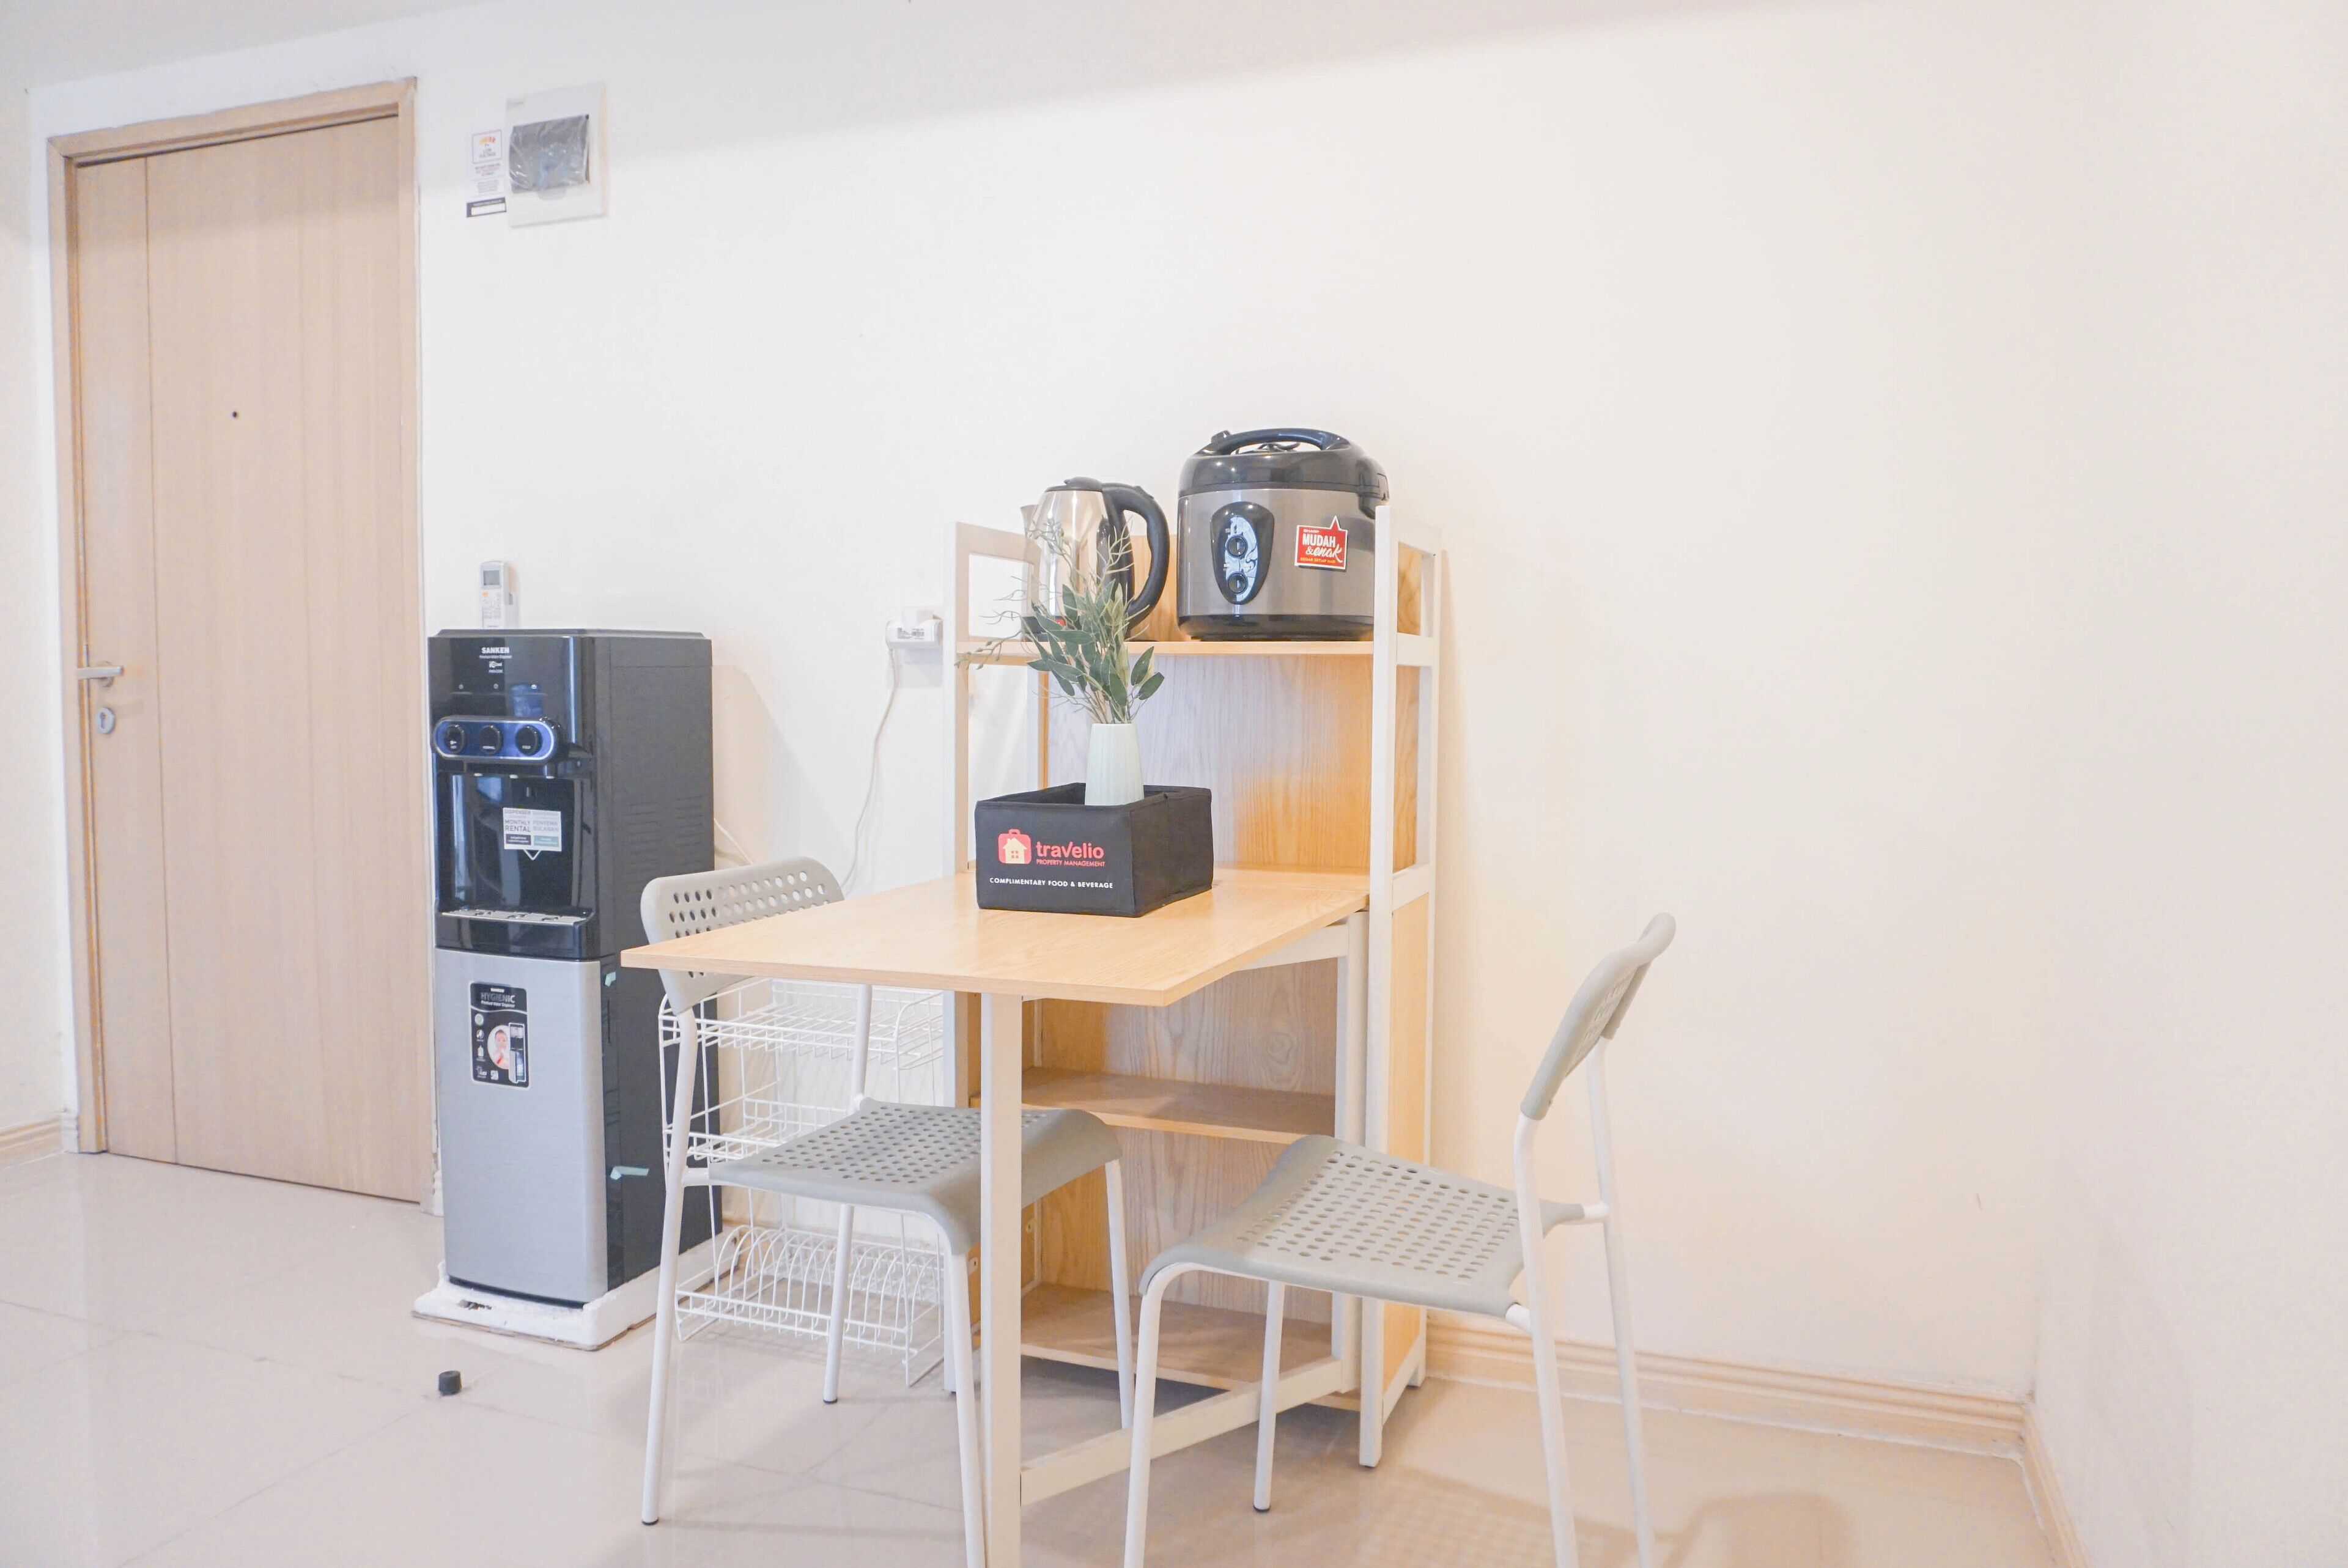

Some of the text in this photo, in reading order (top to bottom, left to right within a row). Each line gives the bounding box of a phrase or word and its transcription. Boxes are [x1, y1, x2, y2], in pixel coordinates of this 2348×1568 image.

[1302, 533, 1335, 548] MUDAH
[1036, 841, 1104, 859] travelio
[990, 877, 1046, 886] COMPLIMENTARY
[481, 992, 515, 1003] HYGIENIC
